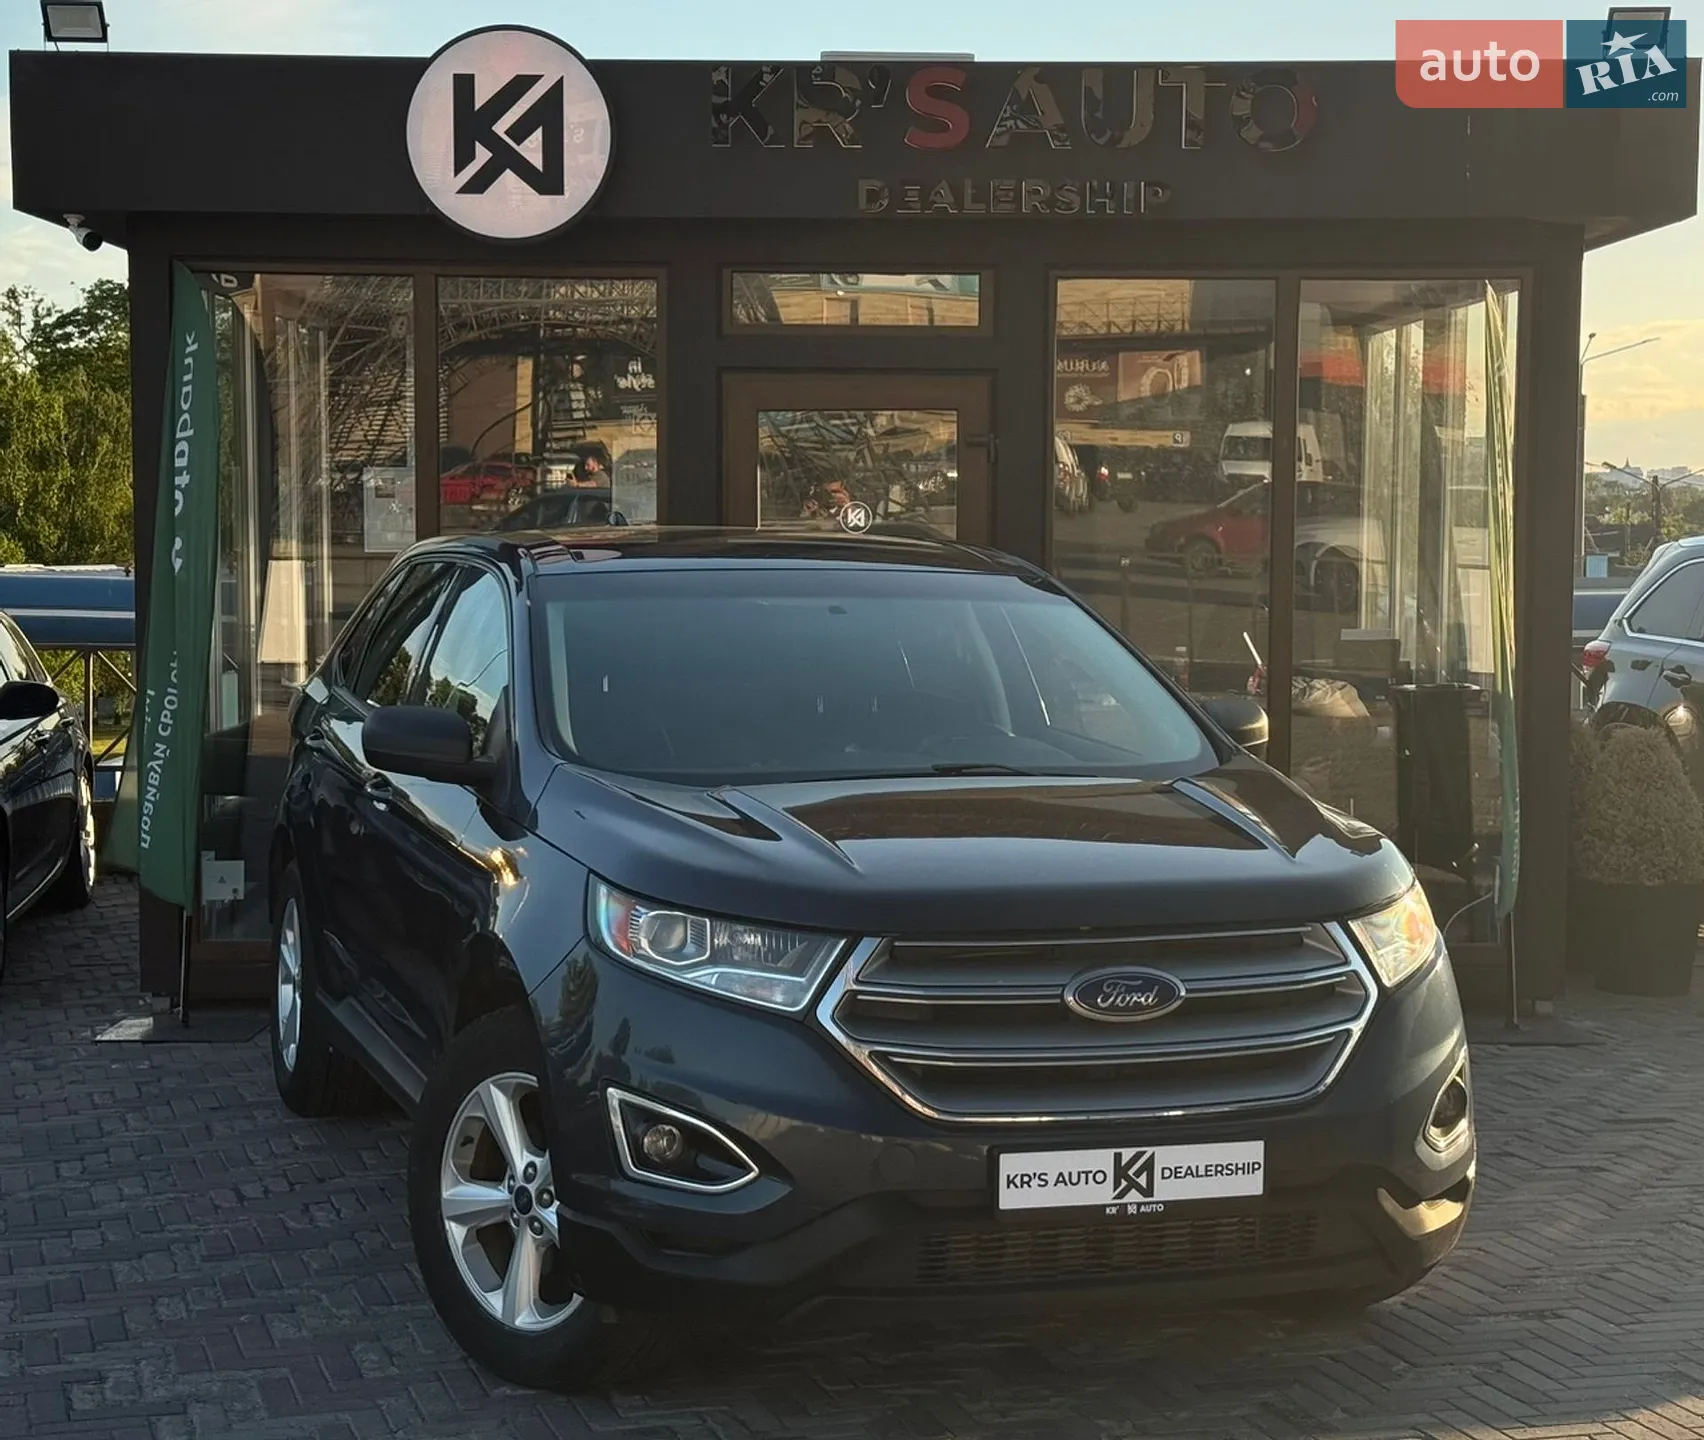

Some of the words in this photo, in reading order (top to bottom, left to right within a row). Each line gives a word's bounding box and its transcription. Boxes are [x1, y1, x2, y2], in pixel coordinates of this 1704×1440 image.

[857, 179, 1172, 214] DEALERSHIP
[1096, 978, 1159, 1008] Ford
[1006, 1171, 1049, 1190] KR'S
[1054, 1169, 1107, 1187] AUTO
[1160, 1161, 1262, 1180] DEALERSHIP
[1140, 1203, 1164, 1213] AUTO
